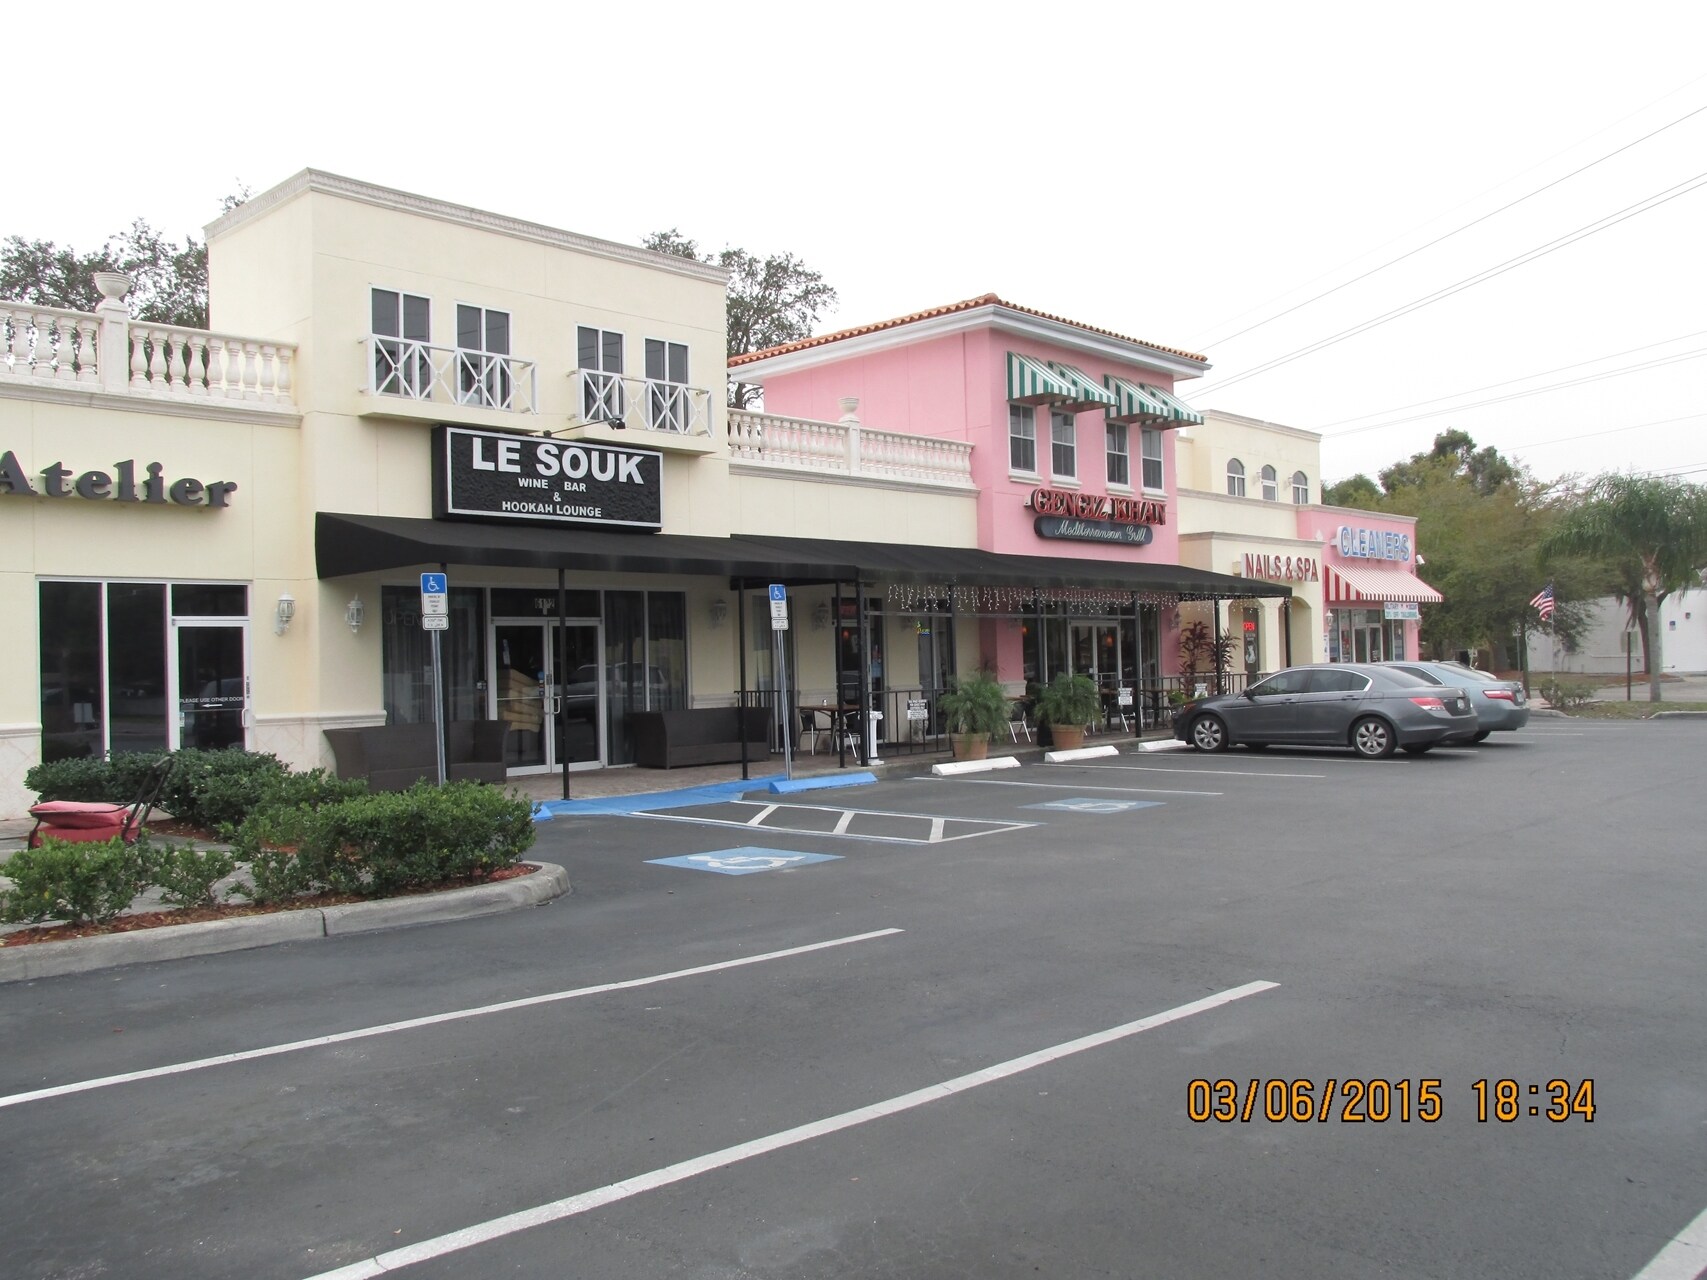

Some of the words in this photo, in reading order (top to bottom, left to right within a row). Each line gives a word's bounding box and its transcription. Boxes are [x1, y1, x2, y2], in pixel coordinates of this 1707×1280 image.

[472, 437, 521, 473] LE
[535, 443, 645, 485] SOUK
[0, 450, 238, 508] Atelier
[518, 477, 549, 489] WINE
[564, 481, 587, 493] BAR
[502, 501, 553, 514] HOOKAH
[556, 504, 602, 518] LOUNGE
[553, 491, 562, 502] &
[1111, 497, 1167, 526] KHAN
[1055, 519, 1122, 539] Mediterranean
[1126, 525, 1147, 541] Grill
[1338, 525, 1410, 562] CLEANERS
[1245, 552, 1282, 581] NAILS
[1285, 556, 1294, 581] &
[1296, 557, 1319, 582] SPA
